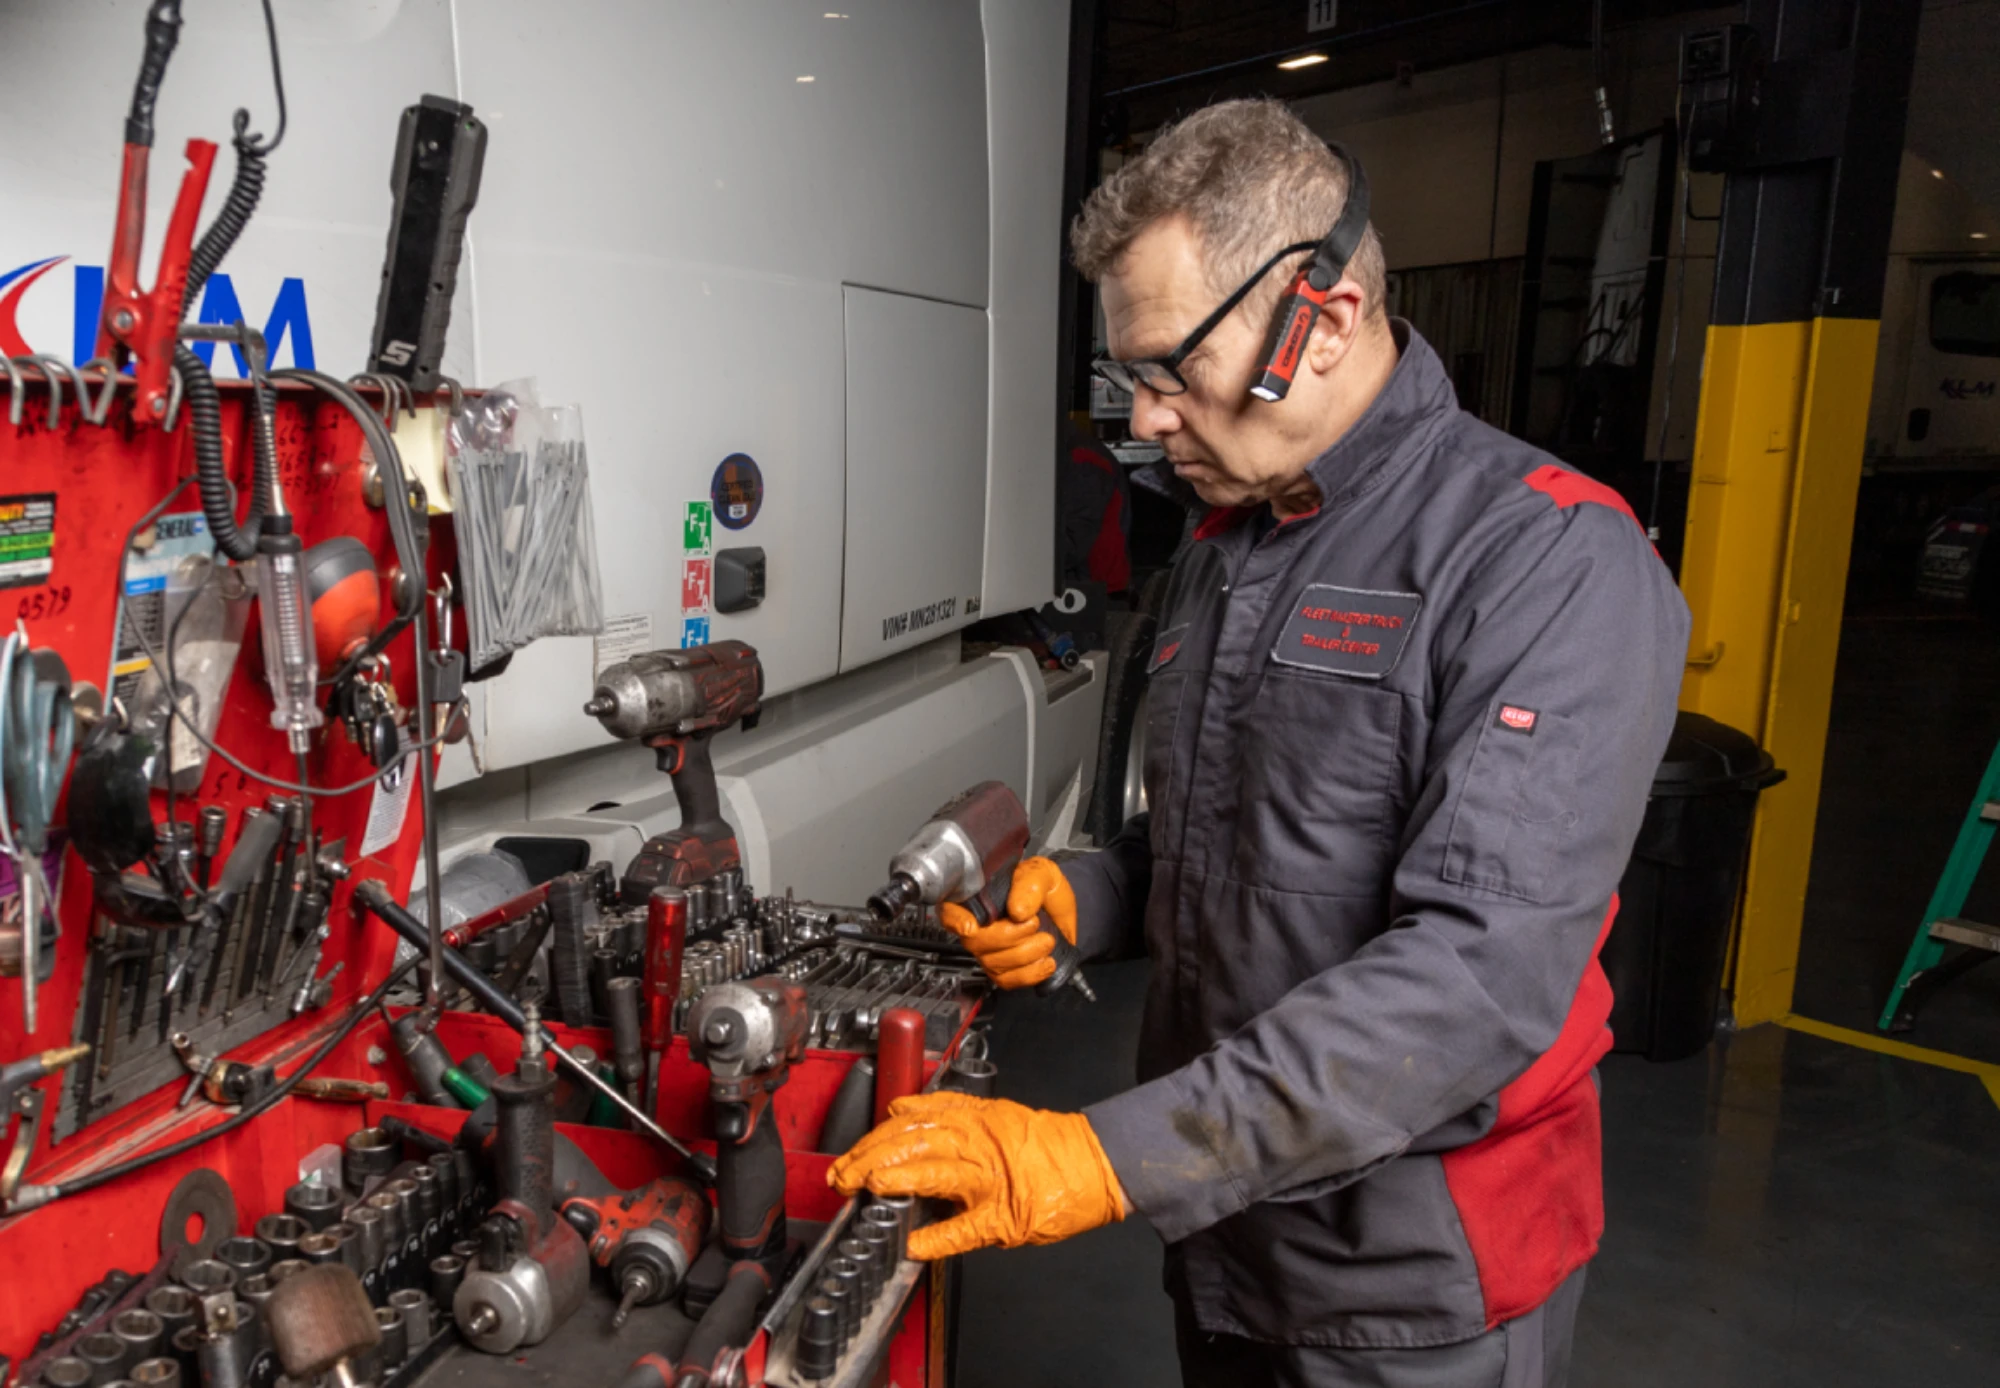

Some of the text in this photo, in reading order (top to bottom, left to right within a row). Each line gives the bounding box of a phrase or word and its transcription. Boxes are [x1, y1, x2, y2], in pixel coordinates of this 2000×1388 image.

[1301, 606, 1404, 628] FLEET MASTER TRUCK
[1302, 634, 1380, 655] TRAILER CENTER
